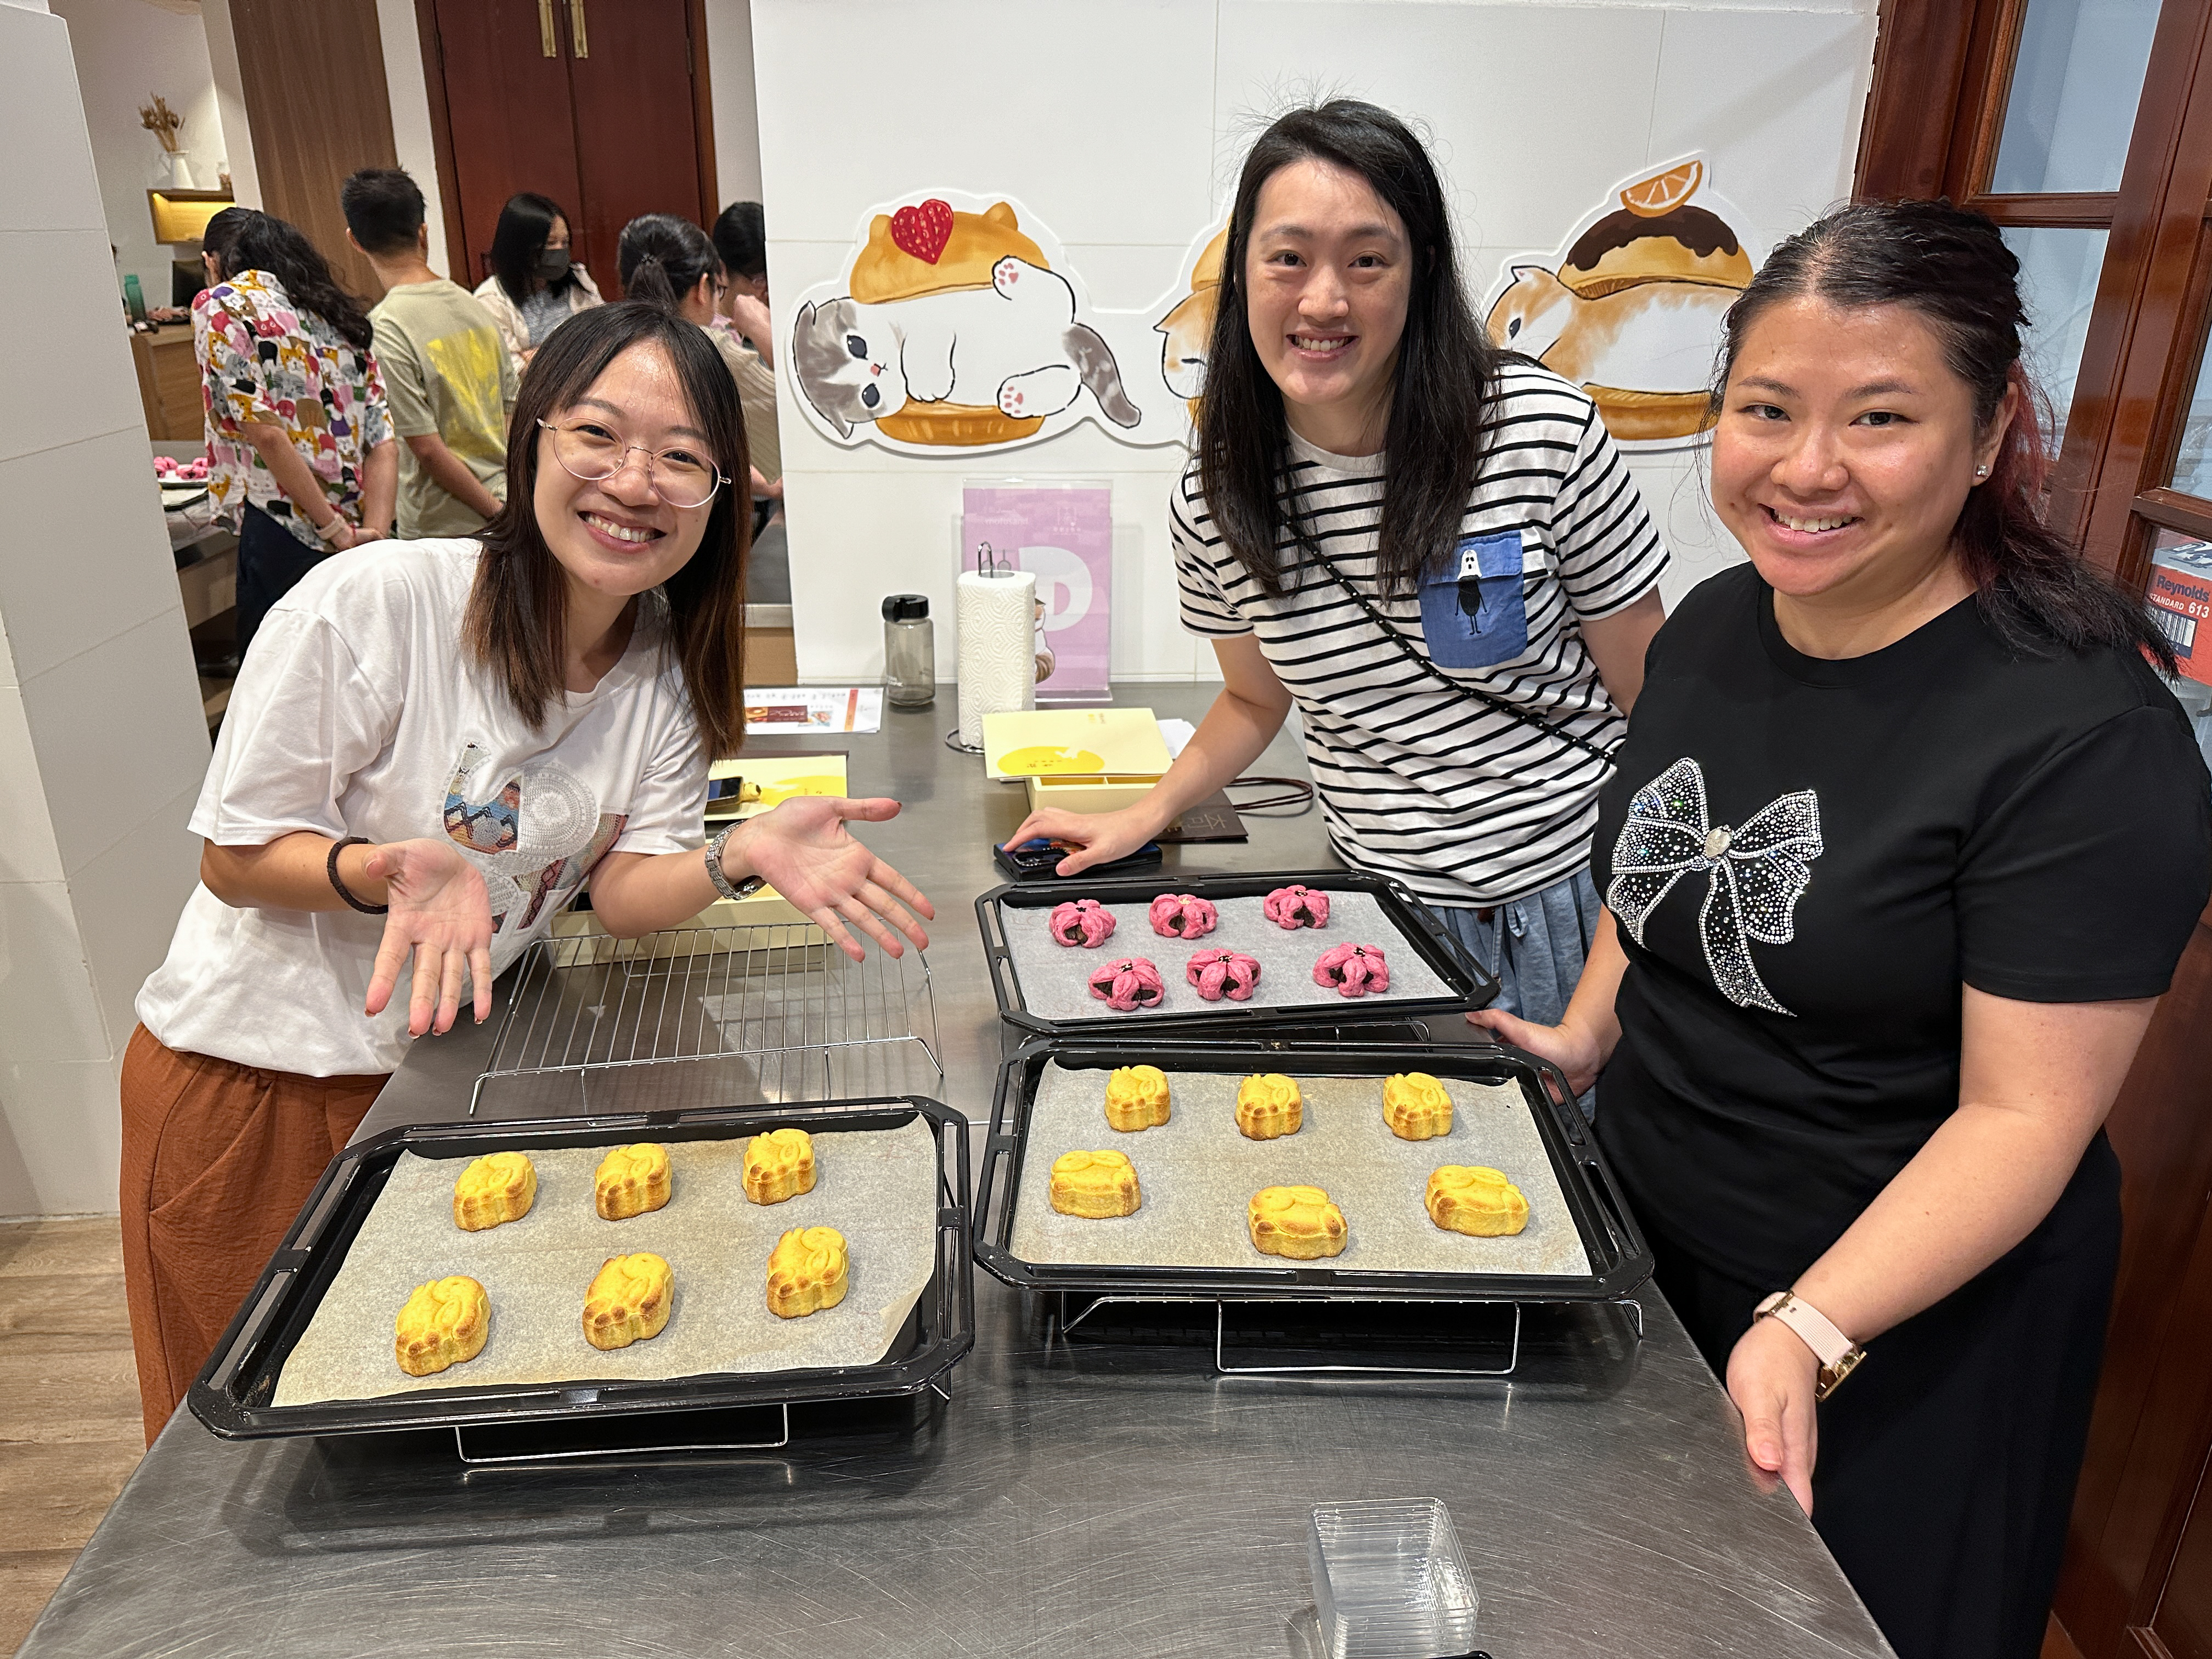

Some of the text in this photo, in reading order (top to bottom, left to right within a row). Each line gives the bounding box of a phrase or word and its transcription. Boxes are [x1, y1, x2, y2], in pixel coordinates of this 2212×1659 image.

[2157, 575, 2210, 602] Reynolds
[2150, 593, 2210, 618] STANDARD 613
